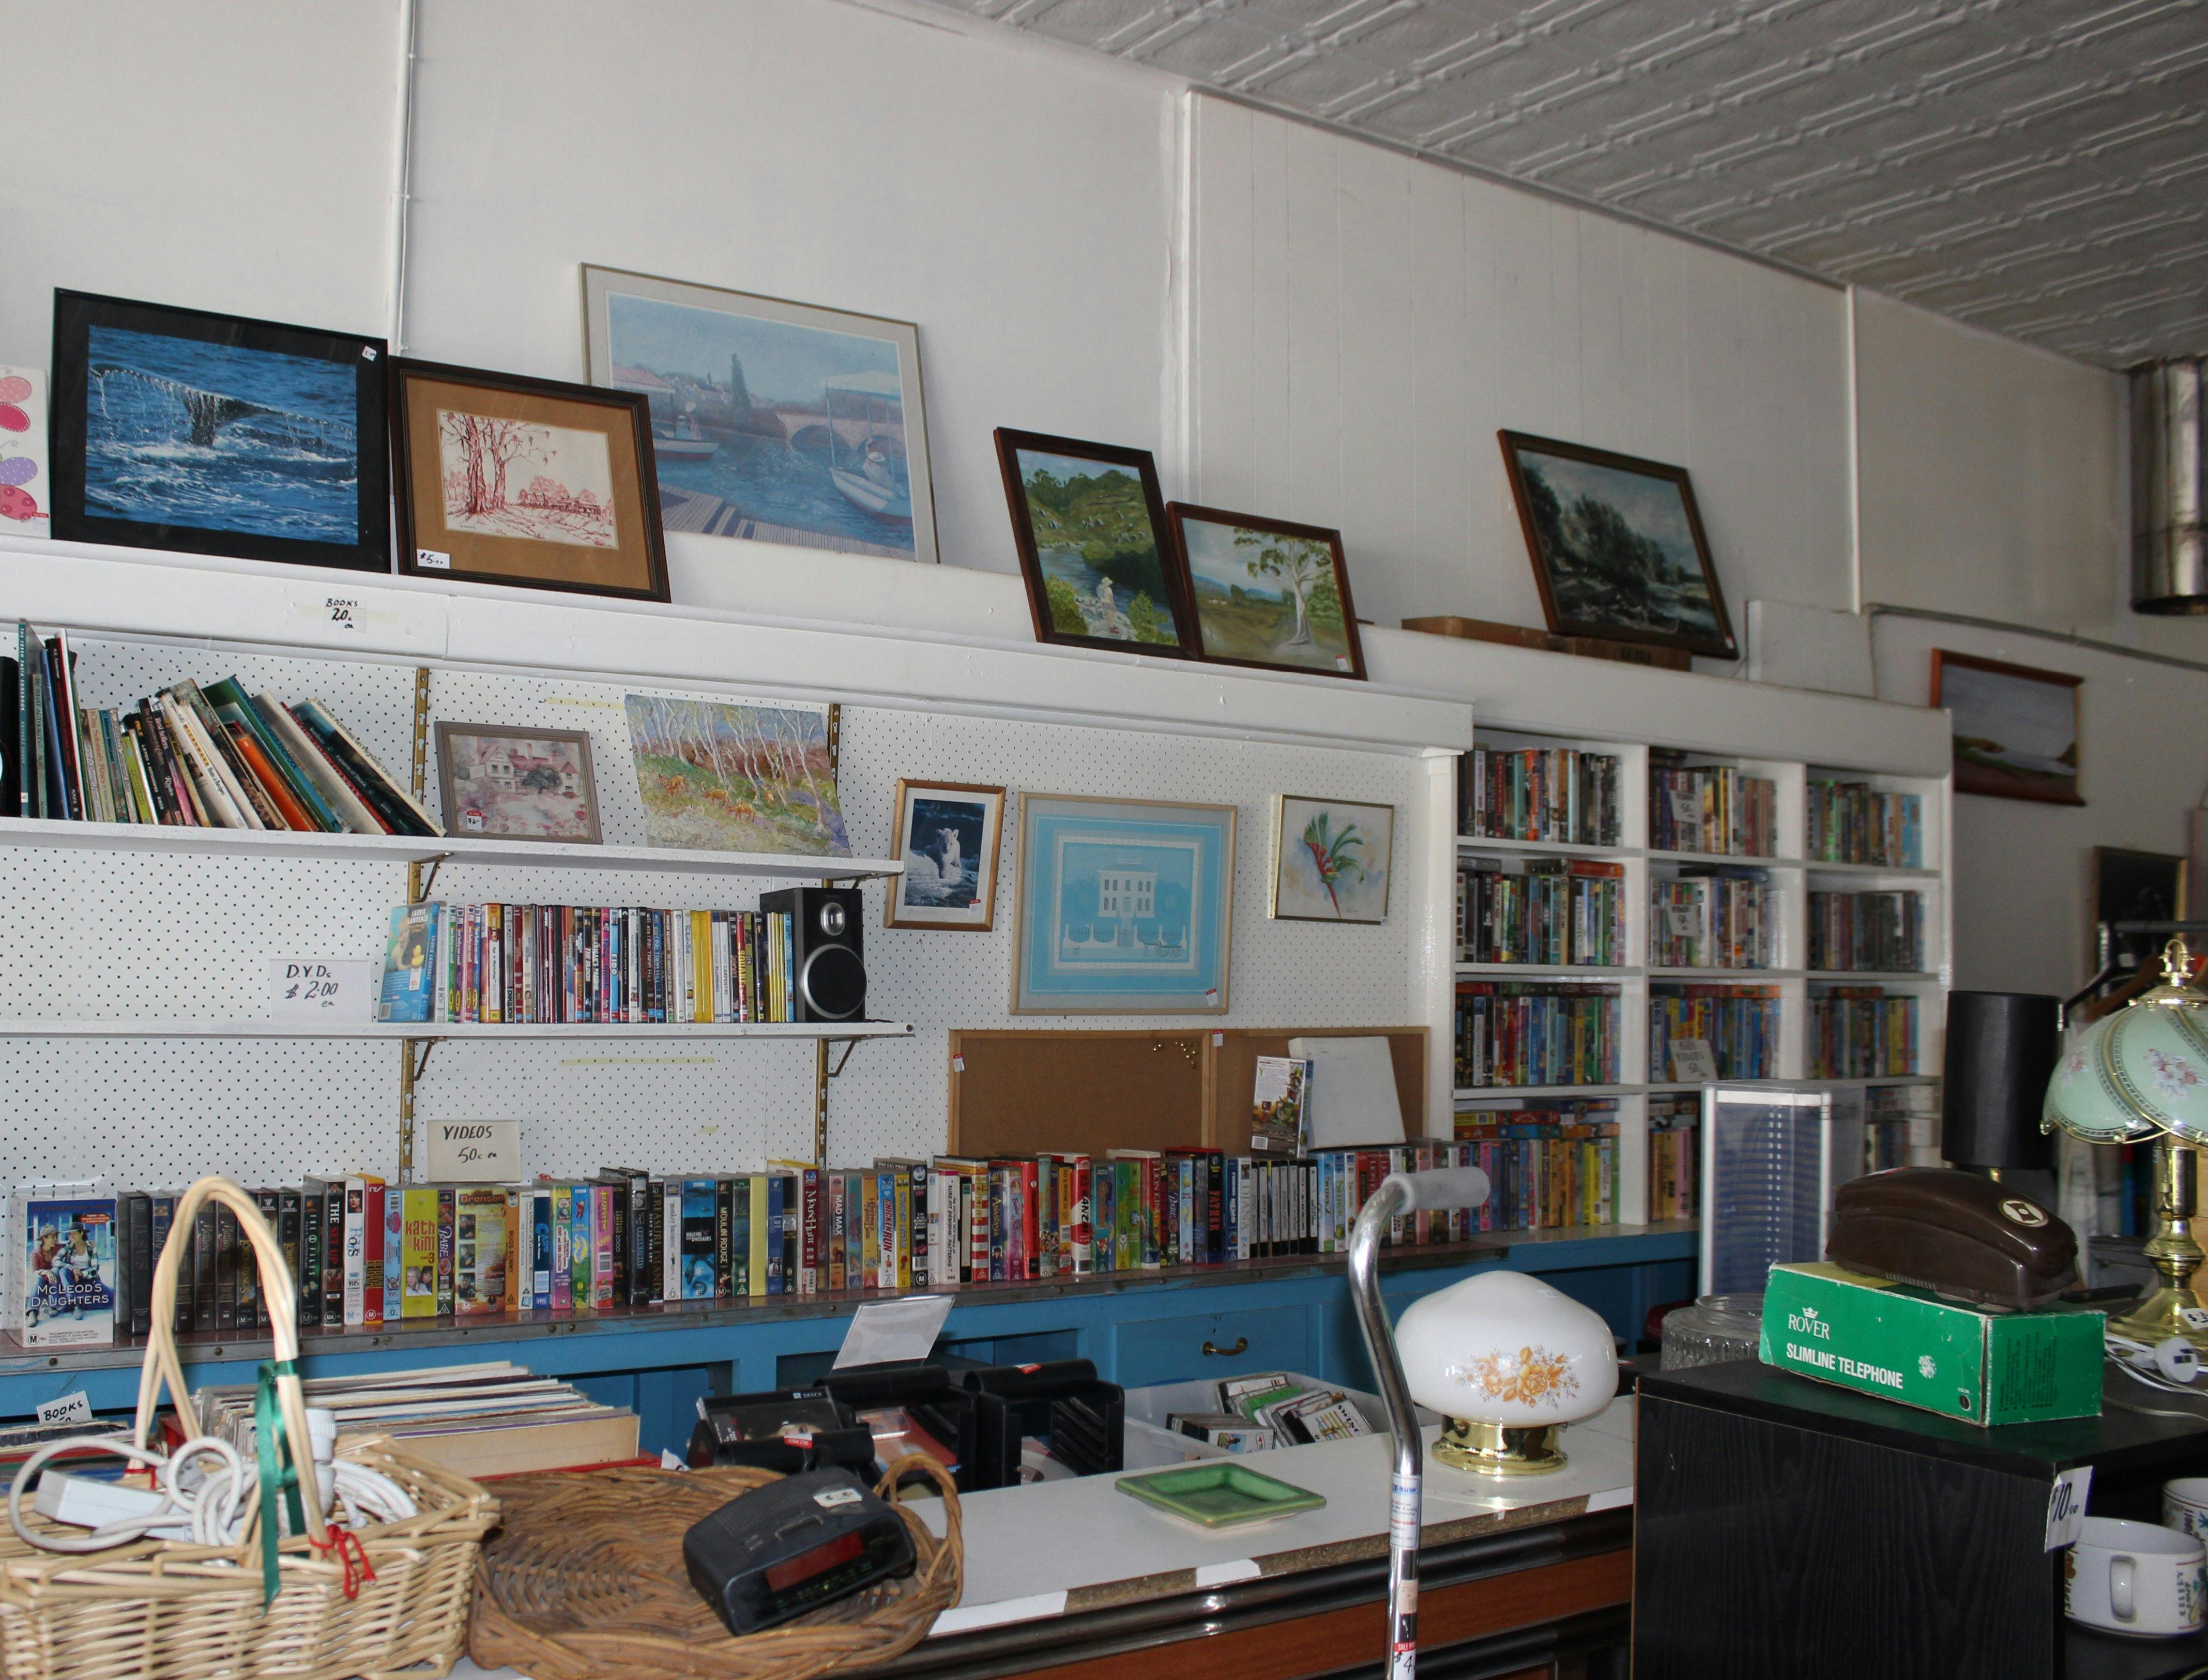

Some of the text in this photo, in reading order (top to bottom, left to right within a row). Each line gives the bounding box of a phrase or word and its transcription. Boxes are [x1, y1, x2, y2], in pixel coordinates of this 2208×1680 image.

[326, 598, 358, 607] BOOKS
[94, 729, 103, 762] Solomon's
[184, 725, 209, 767] MICROWAVE
[316, 699, 393, 778] around Australia on Highway One
[282, 750, 298, 771] POOL
[408, 915, 429, 924] LAWRENCE
[411, 909, 426, 918] LAURIE
[443, 1125, 493, 1140] VIDEOS
[458, 1146, 483, 1164] 50c
[461, 1195, 504, 1203] Bronson
[1168, 1193, 1178, 1219] BABE
[1209, 1190, 1221, 1231] FATHER
[1242, 1185, 1250, 1230] DIANA
[406, 1220, 435, 1235] kath
[773, 1215, 782, 1230] LIFE
[883, 1199, 892, 1252] CHICKEN RUN
[993, 1197, 1002, 1236] ANASTASIA
[154, 1226, 165, 1249] Holy
[330, 1201, 339, 1265] THE SET UP
[414, 1236, 435, 1251] kim
[438, 1226, 452, 1258] BABE
[653, 1194, 662, 1291] TREASURE ISLAND
[134, 1225, 148, 1270] JESUS
[428, 1253, 435, 1263] 3
[240, 1266, 250, 1293] RINGS
[32, 1295, 109, 1307] DAUGHTERS
[1789, 1314, 1830, 1340] ROVER
[1787, 1343, 1904, 1389] SLIMLINE TELEPHONE
[44, 1400, 83, 1421] BOOKS
